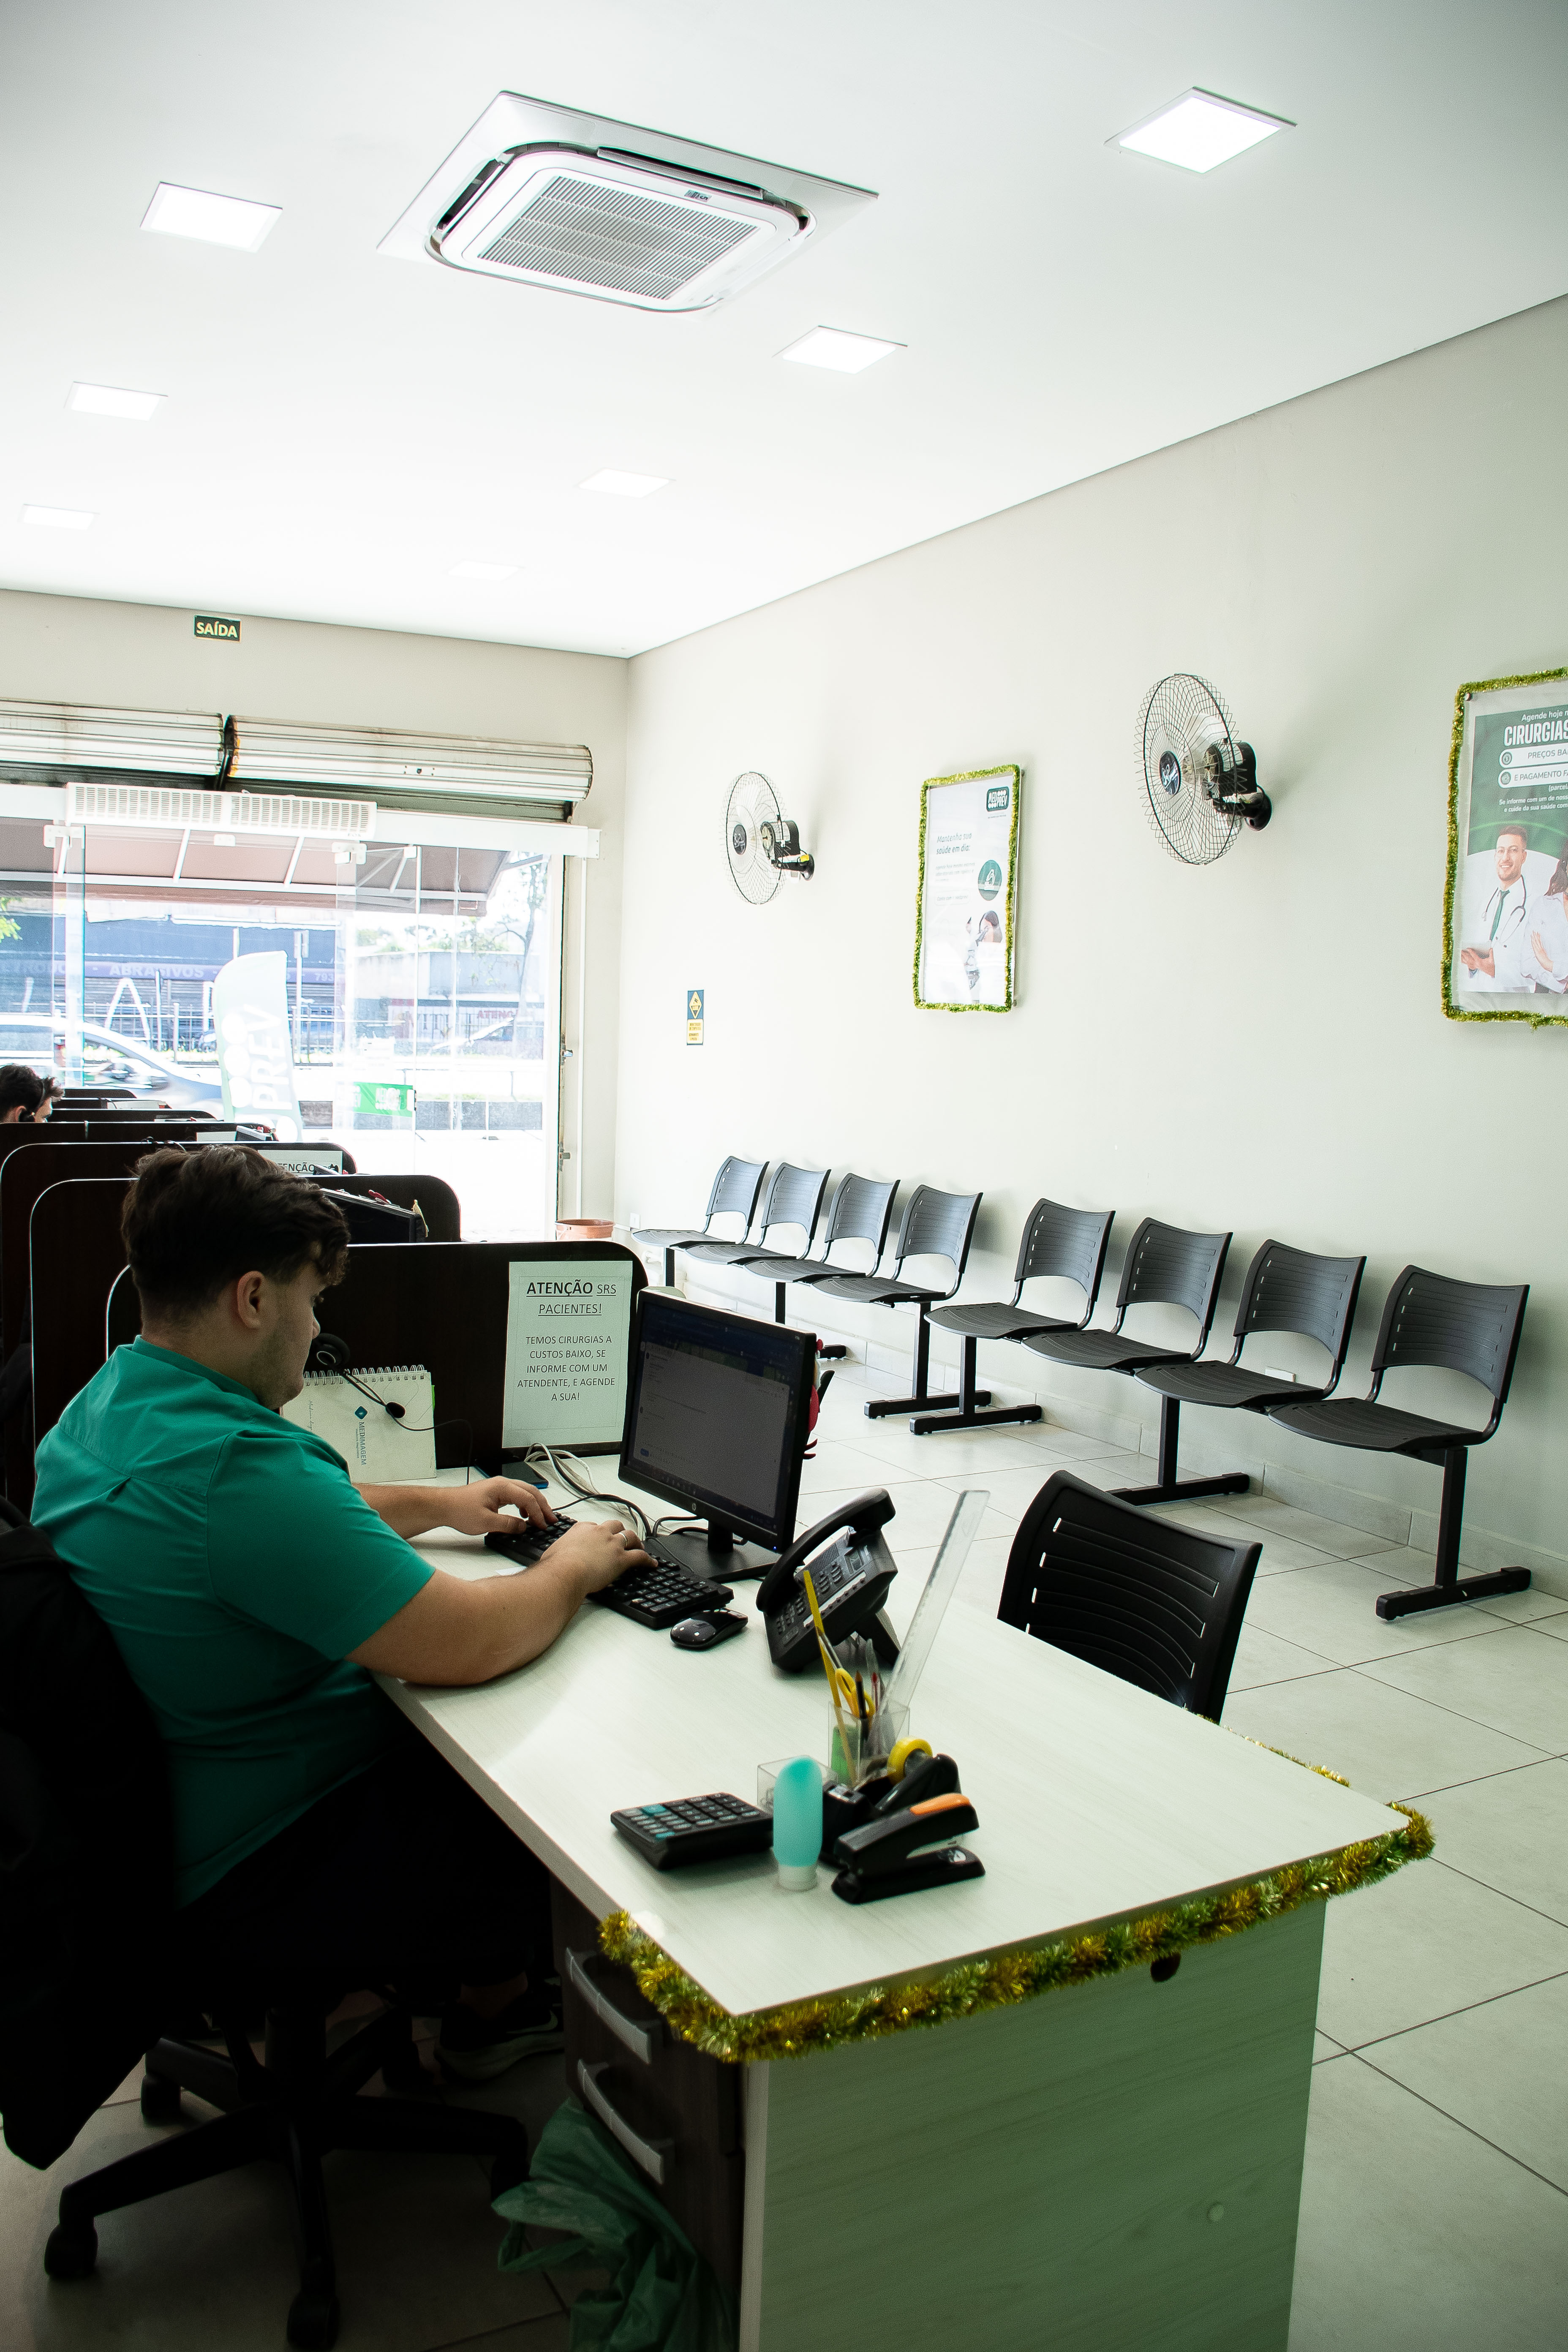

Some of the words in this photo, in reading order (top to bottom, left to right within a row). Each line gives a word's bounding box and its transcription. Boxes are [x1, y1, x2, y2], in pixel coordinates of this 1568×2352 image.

[196, 621, 238, 638] SAÍDA
[1522, 711, 1547, 722] Agende
[1549, 710, 1563, 719] hoje
[1504, 719, 1568, 746] CIRURGIAS
[1527, 750, 1555, 759] PREÇOS
[1520, 770, 1562, 781] PAGAMENTO
[936, 832, 962, 843] Mantenha
[936, 845, 951, 855] saúde
[526, 1279, 593, 1296] ATENÇÃO
[596, 1284, 617, 1295] SRS
[539, 1304, 602, 1314] PACIENTES!
[526, 1336, 556, 1345] TEMOS
[558, 1336, 604, 1344] CIRURGIAS
[530, 1350, 563, 1358] CUSTOS
[566, 1350, 593, 1359] BAIXO,
[527, 1365, 566, 1373] INFORME
[569, 1364, 590, 1372] COM
[517, 1379, 570, 1388] ATENDENTE,
[580, 1378, 615, 1386] AGENDE
[560, 1392, 580, 1401] SUA!
